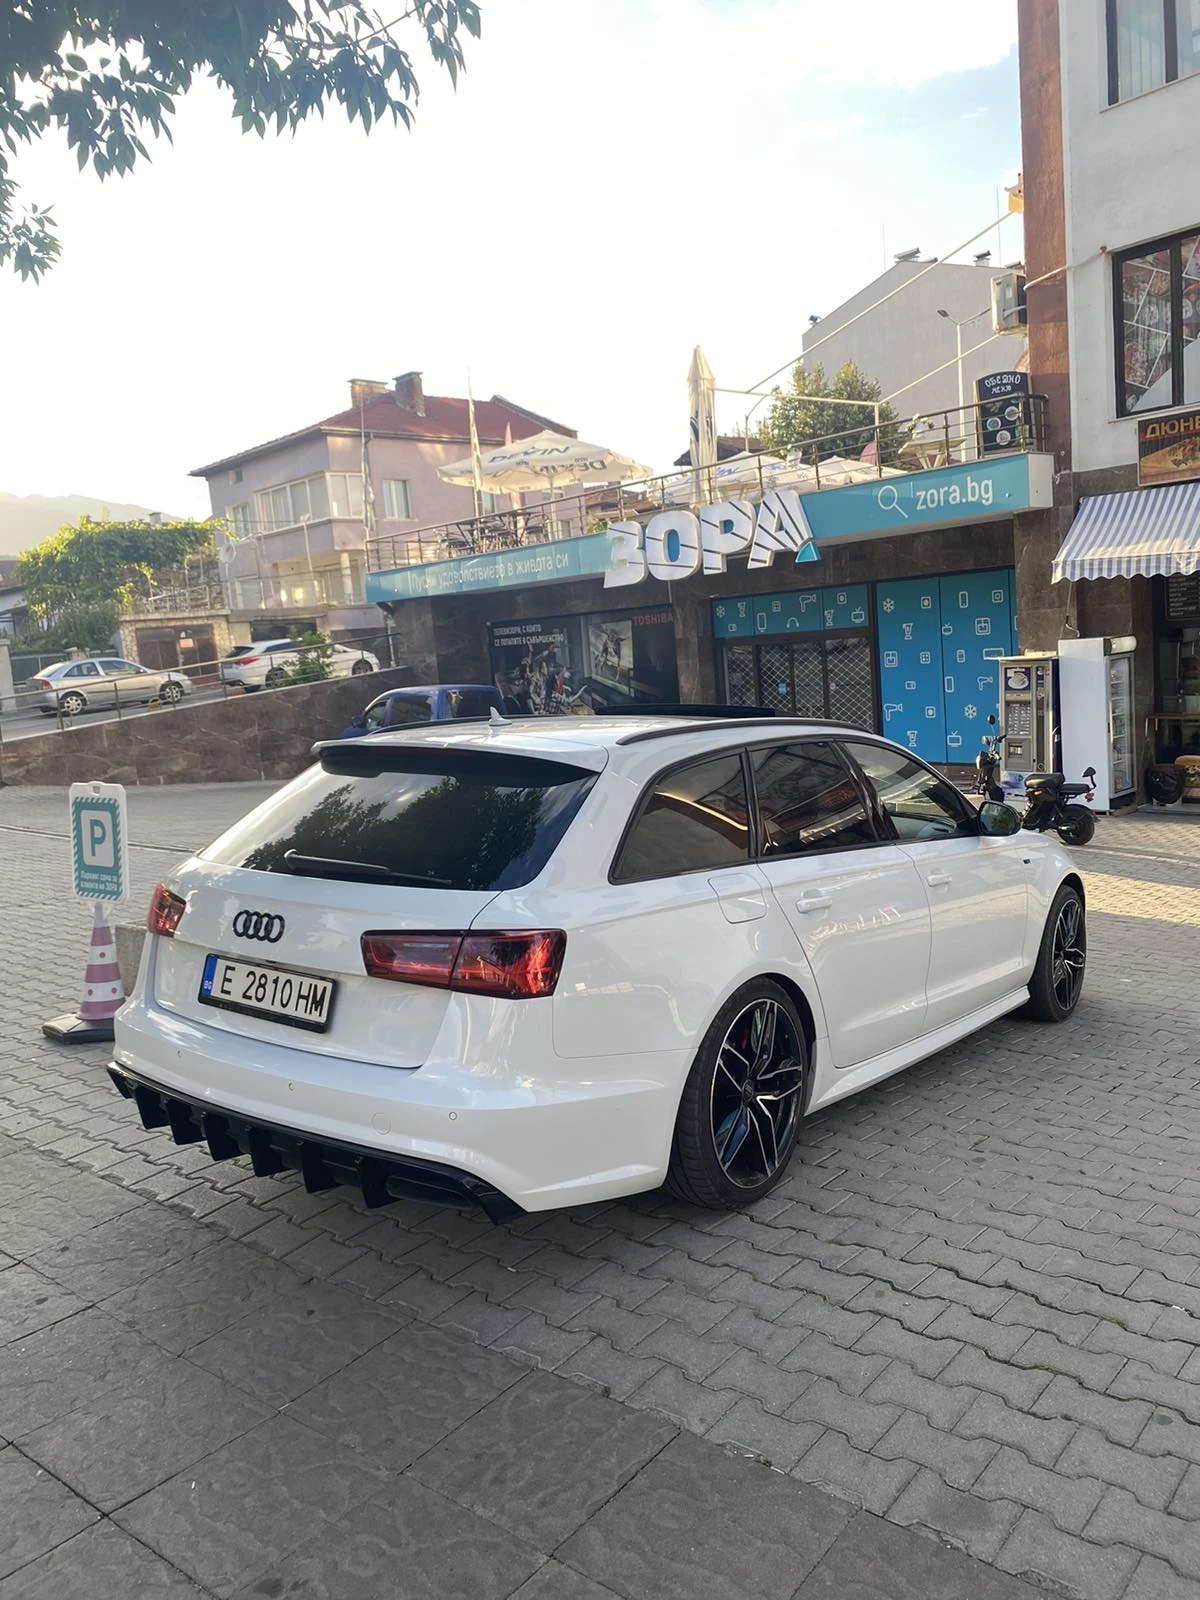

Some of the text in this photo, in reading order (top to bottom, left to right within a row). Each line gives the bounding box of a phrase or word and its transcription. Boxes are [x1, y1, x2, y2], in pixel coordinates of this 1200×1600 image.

[915, 475, 993, 511] zora.bg
[603, 489, 820, 589] ЗОРА
[507, 562, 514, 576] в
[516, 556, 553, 576] живота
[556, 552, 569, 568] си
[632, 612, 674, 625] TOSHIBA
[89, 818, 107, 857] P
[220, 965, 328, 1017] E 2810 HM
